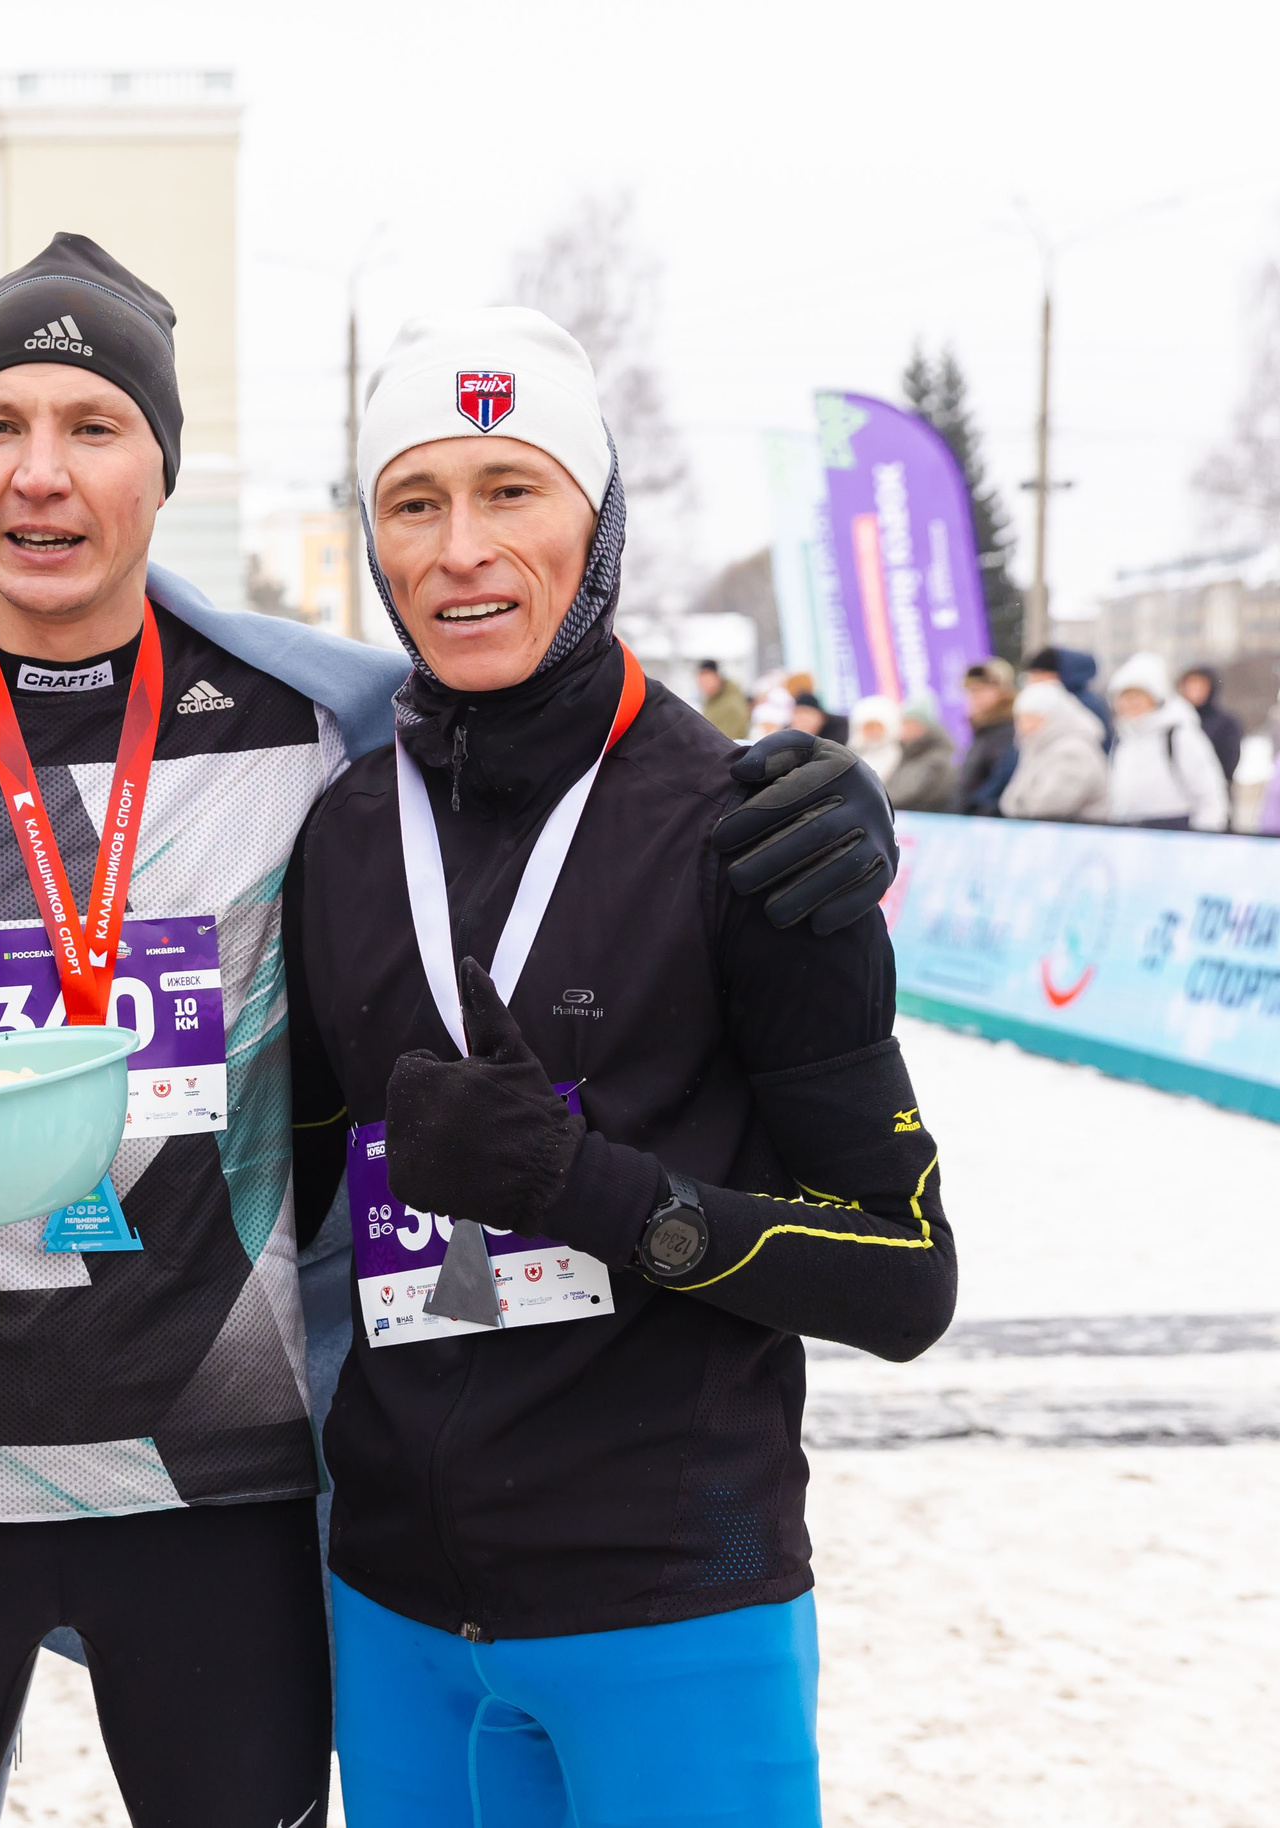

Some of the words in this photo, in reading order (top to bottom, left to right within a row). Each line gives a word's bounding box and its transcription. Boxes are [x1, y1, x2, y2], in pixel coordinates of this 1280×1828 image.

[23, 335, 93, 357] adidas
[23, 671, 90, 688] CRAFT
[176, 696, 235, 715] adidas
[95, 831, 126, 940] КАЛАШНИКОВ
[116, 780, 135, 828] СПОРТ
[24, 817, 66, 923] КАЛАШНИКОВ
[59, 920, 82, 976] СПОРТ
[12, 950, 55, 960] РОССЕЛЬХ
[167, 976, 201, 987] ИЖЕВСК
[174, 997, 198, 1016] 10
[553, 1005, 603, 1020] Kalenji
[175, 1016, 199, 1031] КМ
[367, 1145, 386, 1157] КУБО
[64, 1215, 110, 1224] ПЕЛЬМЕННЫЙ
[654, 1260, 671, 1270] GARMIN
